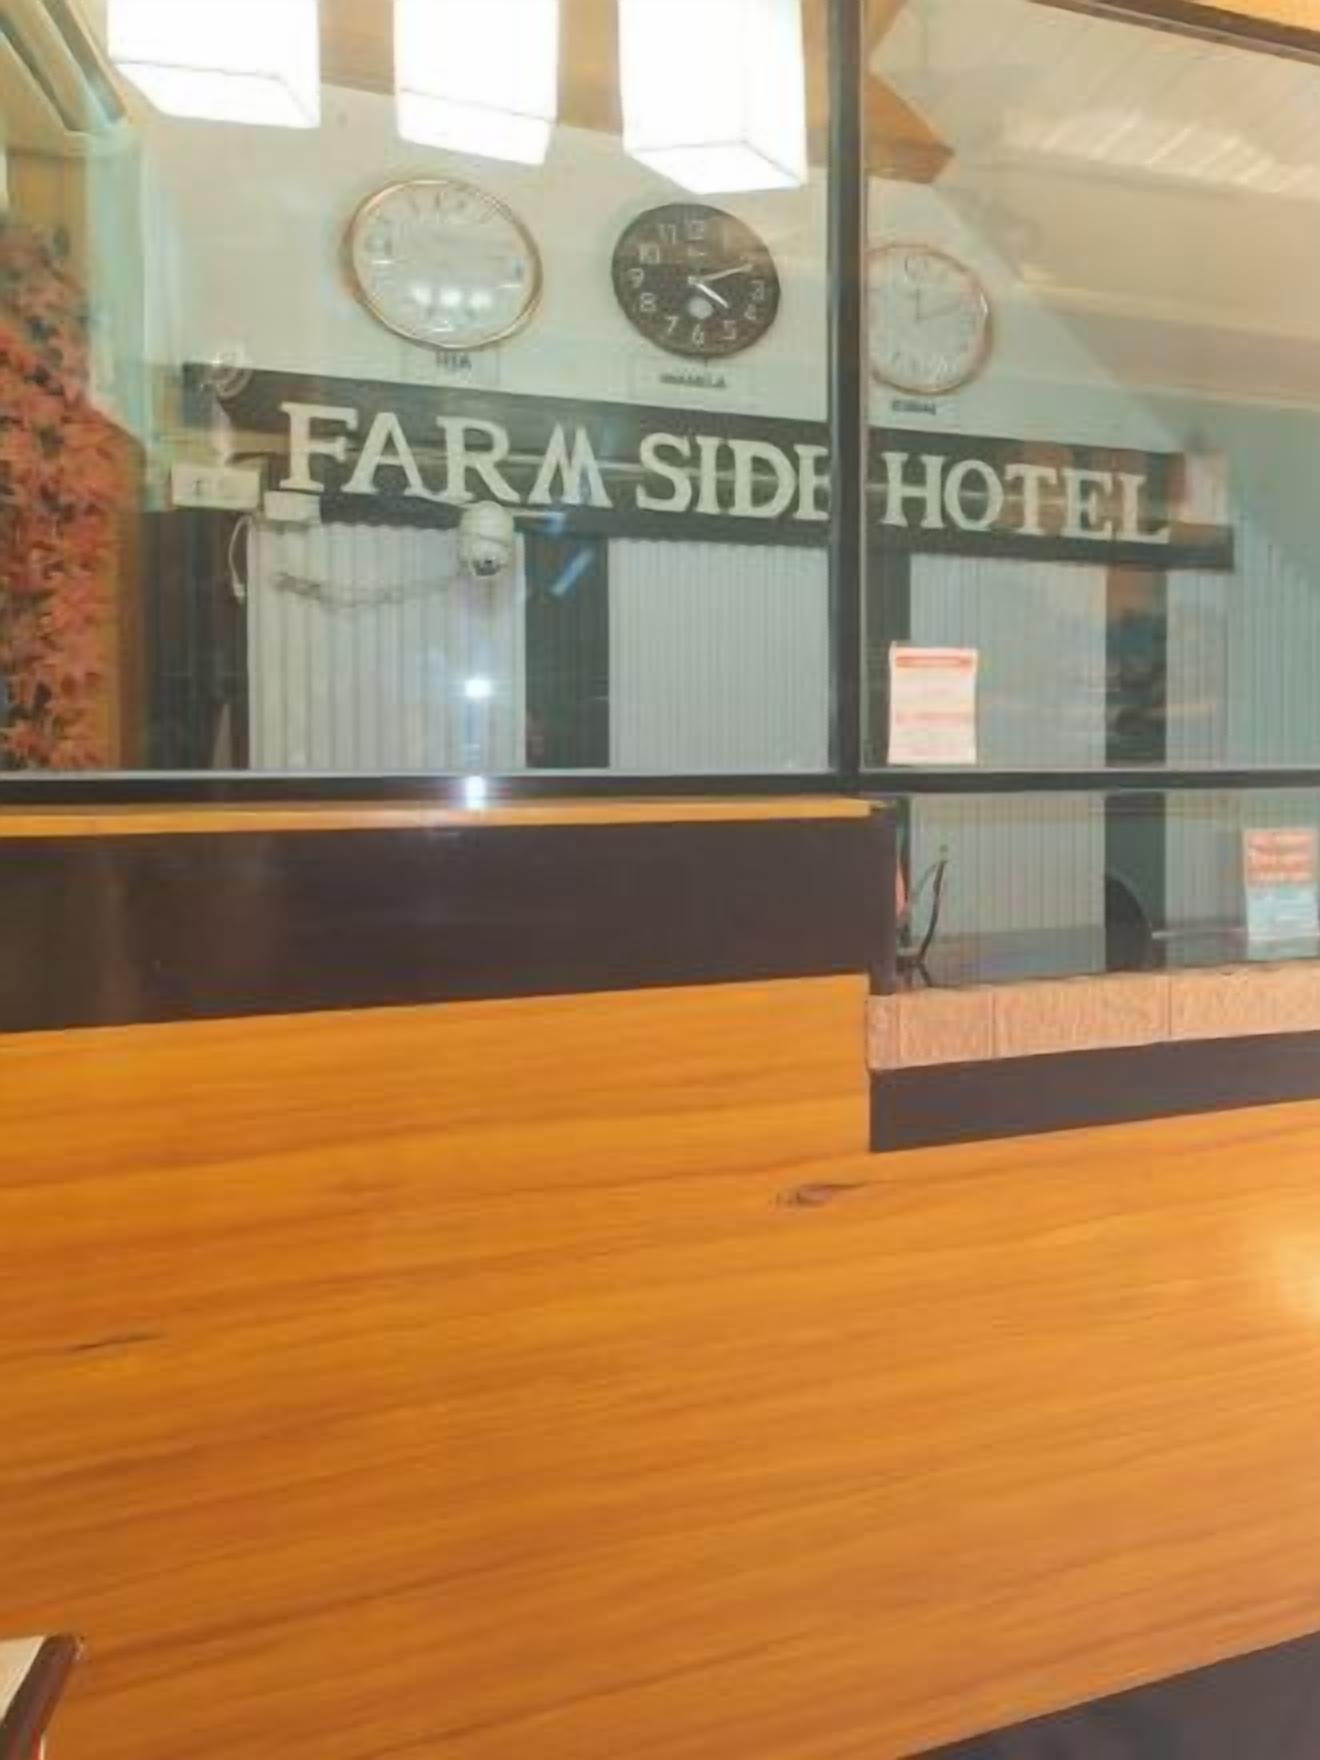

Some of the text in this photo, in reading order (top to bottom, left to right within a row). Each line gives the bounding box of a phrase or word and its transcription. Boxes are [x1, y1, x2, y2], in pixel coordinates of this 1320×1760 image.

[664, 315, 680, 335] 7
[692, 322, 705, 345] 6
[278, 402, 614, 508] FARM
[880, 452, 1172, 544] HOTEL
